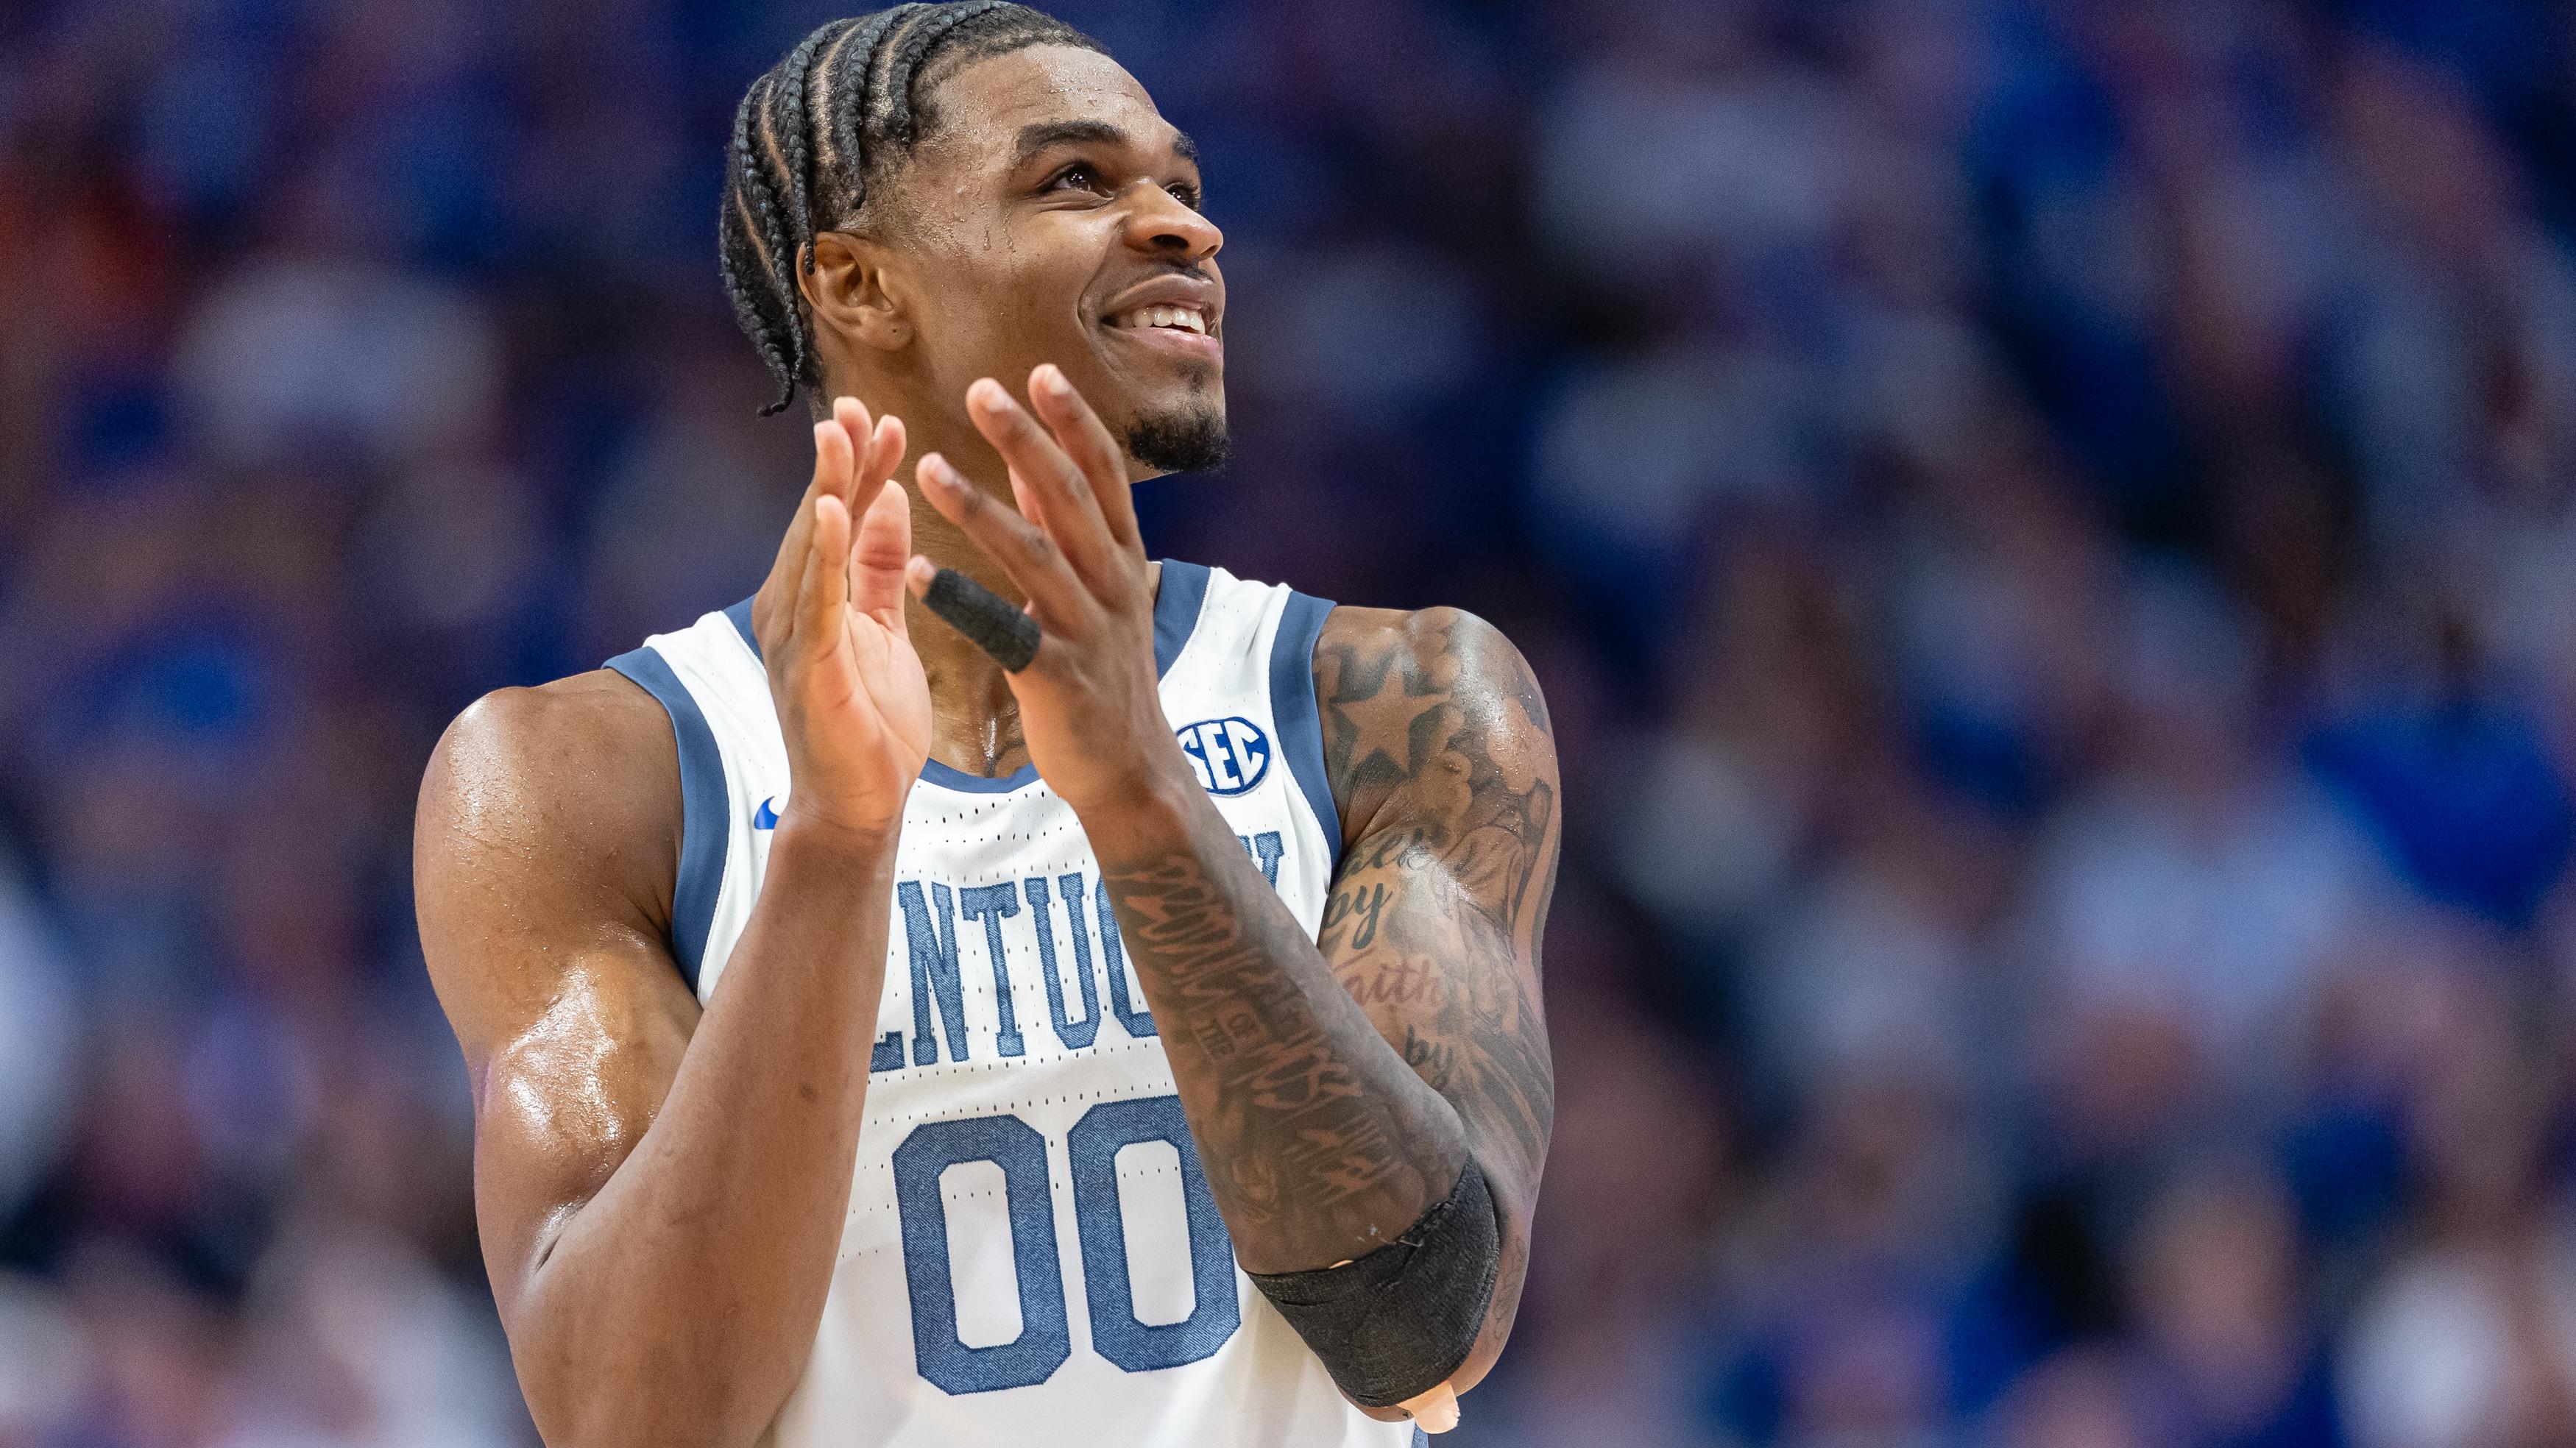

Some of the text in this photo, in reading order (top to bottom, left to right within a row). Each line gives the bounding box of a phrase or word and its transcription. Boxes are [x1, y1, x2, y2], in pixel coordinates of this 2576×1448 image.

[1177, 720, 1265, 791] SEC
[1334, 948, 1440, 1007] aith
[1405, 1025, 1454, 1090] by
[892, 1094, 1242, 1396] 00
